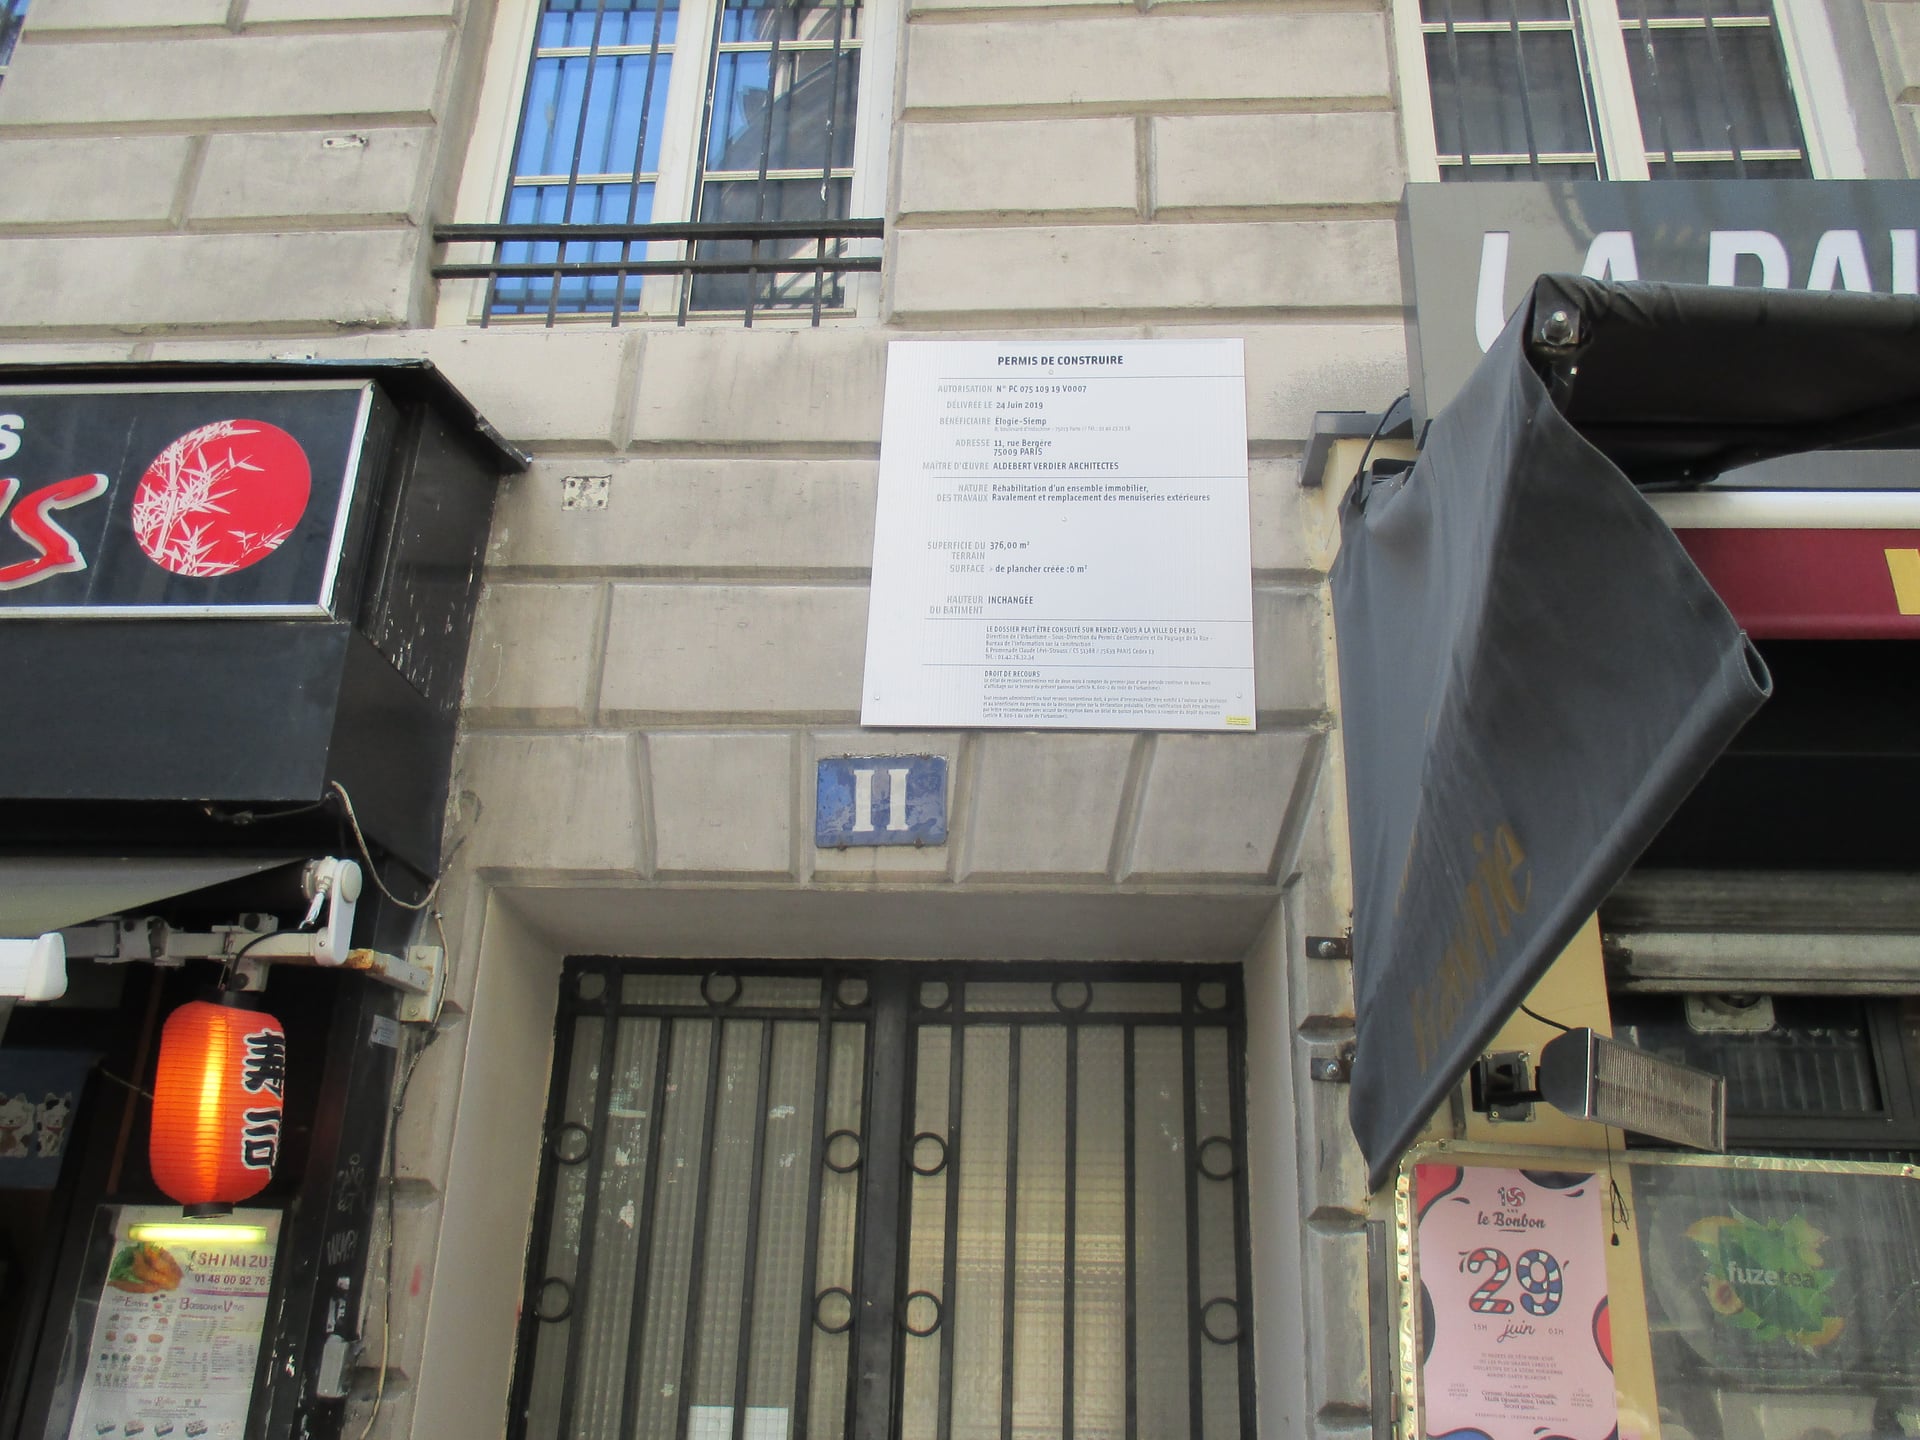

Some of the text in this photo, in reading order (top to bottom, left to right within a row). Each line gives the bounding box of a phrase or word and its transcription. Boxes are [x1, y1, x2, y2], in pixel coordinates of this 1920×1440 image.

[998, 355, 1124, 366] PERMIS DE CONSTRUIRE
[937, 385, 993, 394] AUTORISATION
[1008, 385, 1018, 394] PC
[1020, 385, 1033, 394] 075
[1035, 385, 1049, 394] 109
[1052, 385, 1061, 394] 19
[1063, 385, 1087, 394] V0007
[947, 400, 1043, 409] DÉLIVRÉE LE 24 Juin 2019
[955, 439, 990, 447] ADRESSE
[994, 439, 1005, 448] 11,
[993, 448, 1043, 456] 75009 PARIS
[922, 461, 1119, 470] MAÎTRE D'ŒUVRE ALDEBERT VERDIER ARCHITECTES
[958, 484, 988, 492] NATURE
[1048, 484, 1065, 492] d'un
[1067, 484, 1103, 492] ensemble
[1105, 484, 1149, 493] immobilier,
[937, 494, 1211, 503] DES TRAVAUX Ravalement et remplacement des menuiseries extérieures
[927, 541, 972, 550] SUPERFICIE
[974, 541, 986, 550] DU
[990, 541, 1017, 551] 376,00
[952, 552, 985, 560] TERRAIN
[949, 564, 985, 573] SURFACE
[995, 564, 1005, 573] de
[1006, 564, 1041, 574] plancher
[946, 595, 1034, 604] HAUTEUR INCHANGÉE
[929, 606, 941, 615] DU
[1036, 625, 1050, 633] ÊTRE
[1052, 625, 1080, 633] CONSULTÉ
[1095, 626, 1137, 634] RENDEZ-VOUS
[852, 768, 909, 832] 11
[1497, 1186, 1526, 1207] 10
[1477, 1211, 1546, 1229] le Bonbon
[197, 1252, 268, 1268] SHIMIZU
[194, 1273, 266, 1285] 01 48 00 92 76
[1467, 1247, 1563, 1317] 29
[1496, 1319, 1536, 1343] juin
